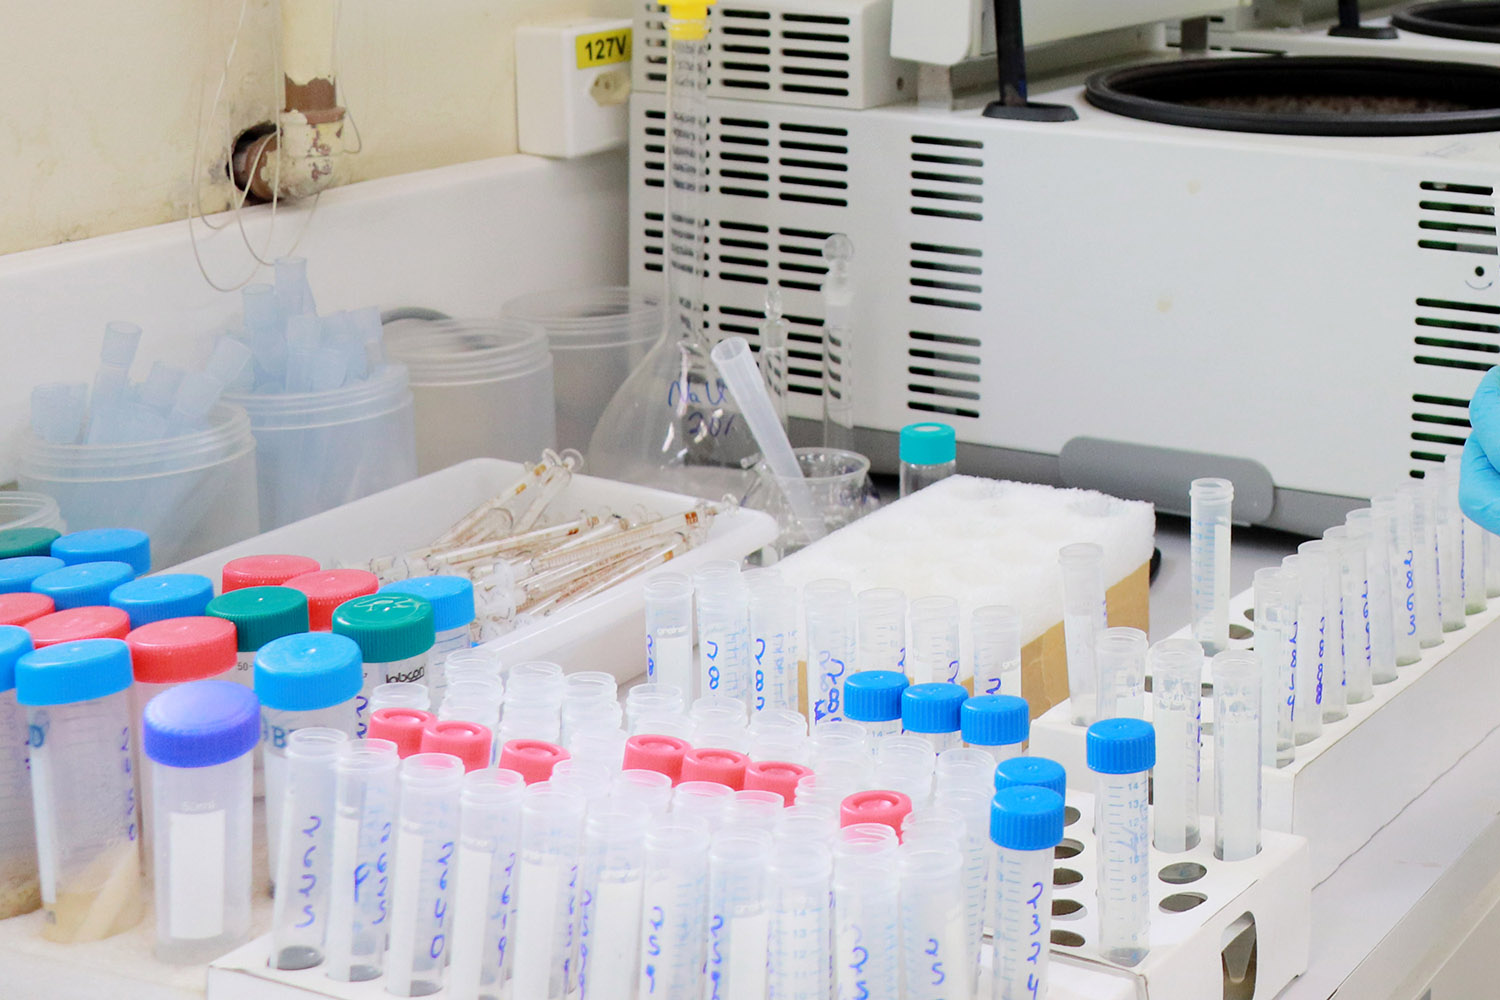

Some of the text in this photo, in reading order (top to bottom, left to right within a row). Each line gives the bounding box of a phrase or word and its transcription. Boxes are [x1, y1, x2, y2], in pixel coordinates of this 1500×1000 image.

[584, 34, 627, 62] 127V
[237, 662, 249, 671] 50
[295, 815, 322, 929] 2625
[430, 841, 455, 959] 2640
[1026, 882, 1044, 1000] 2324
